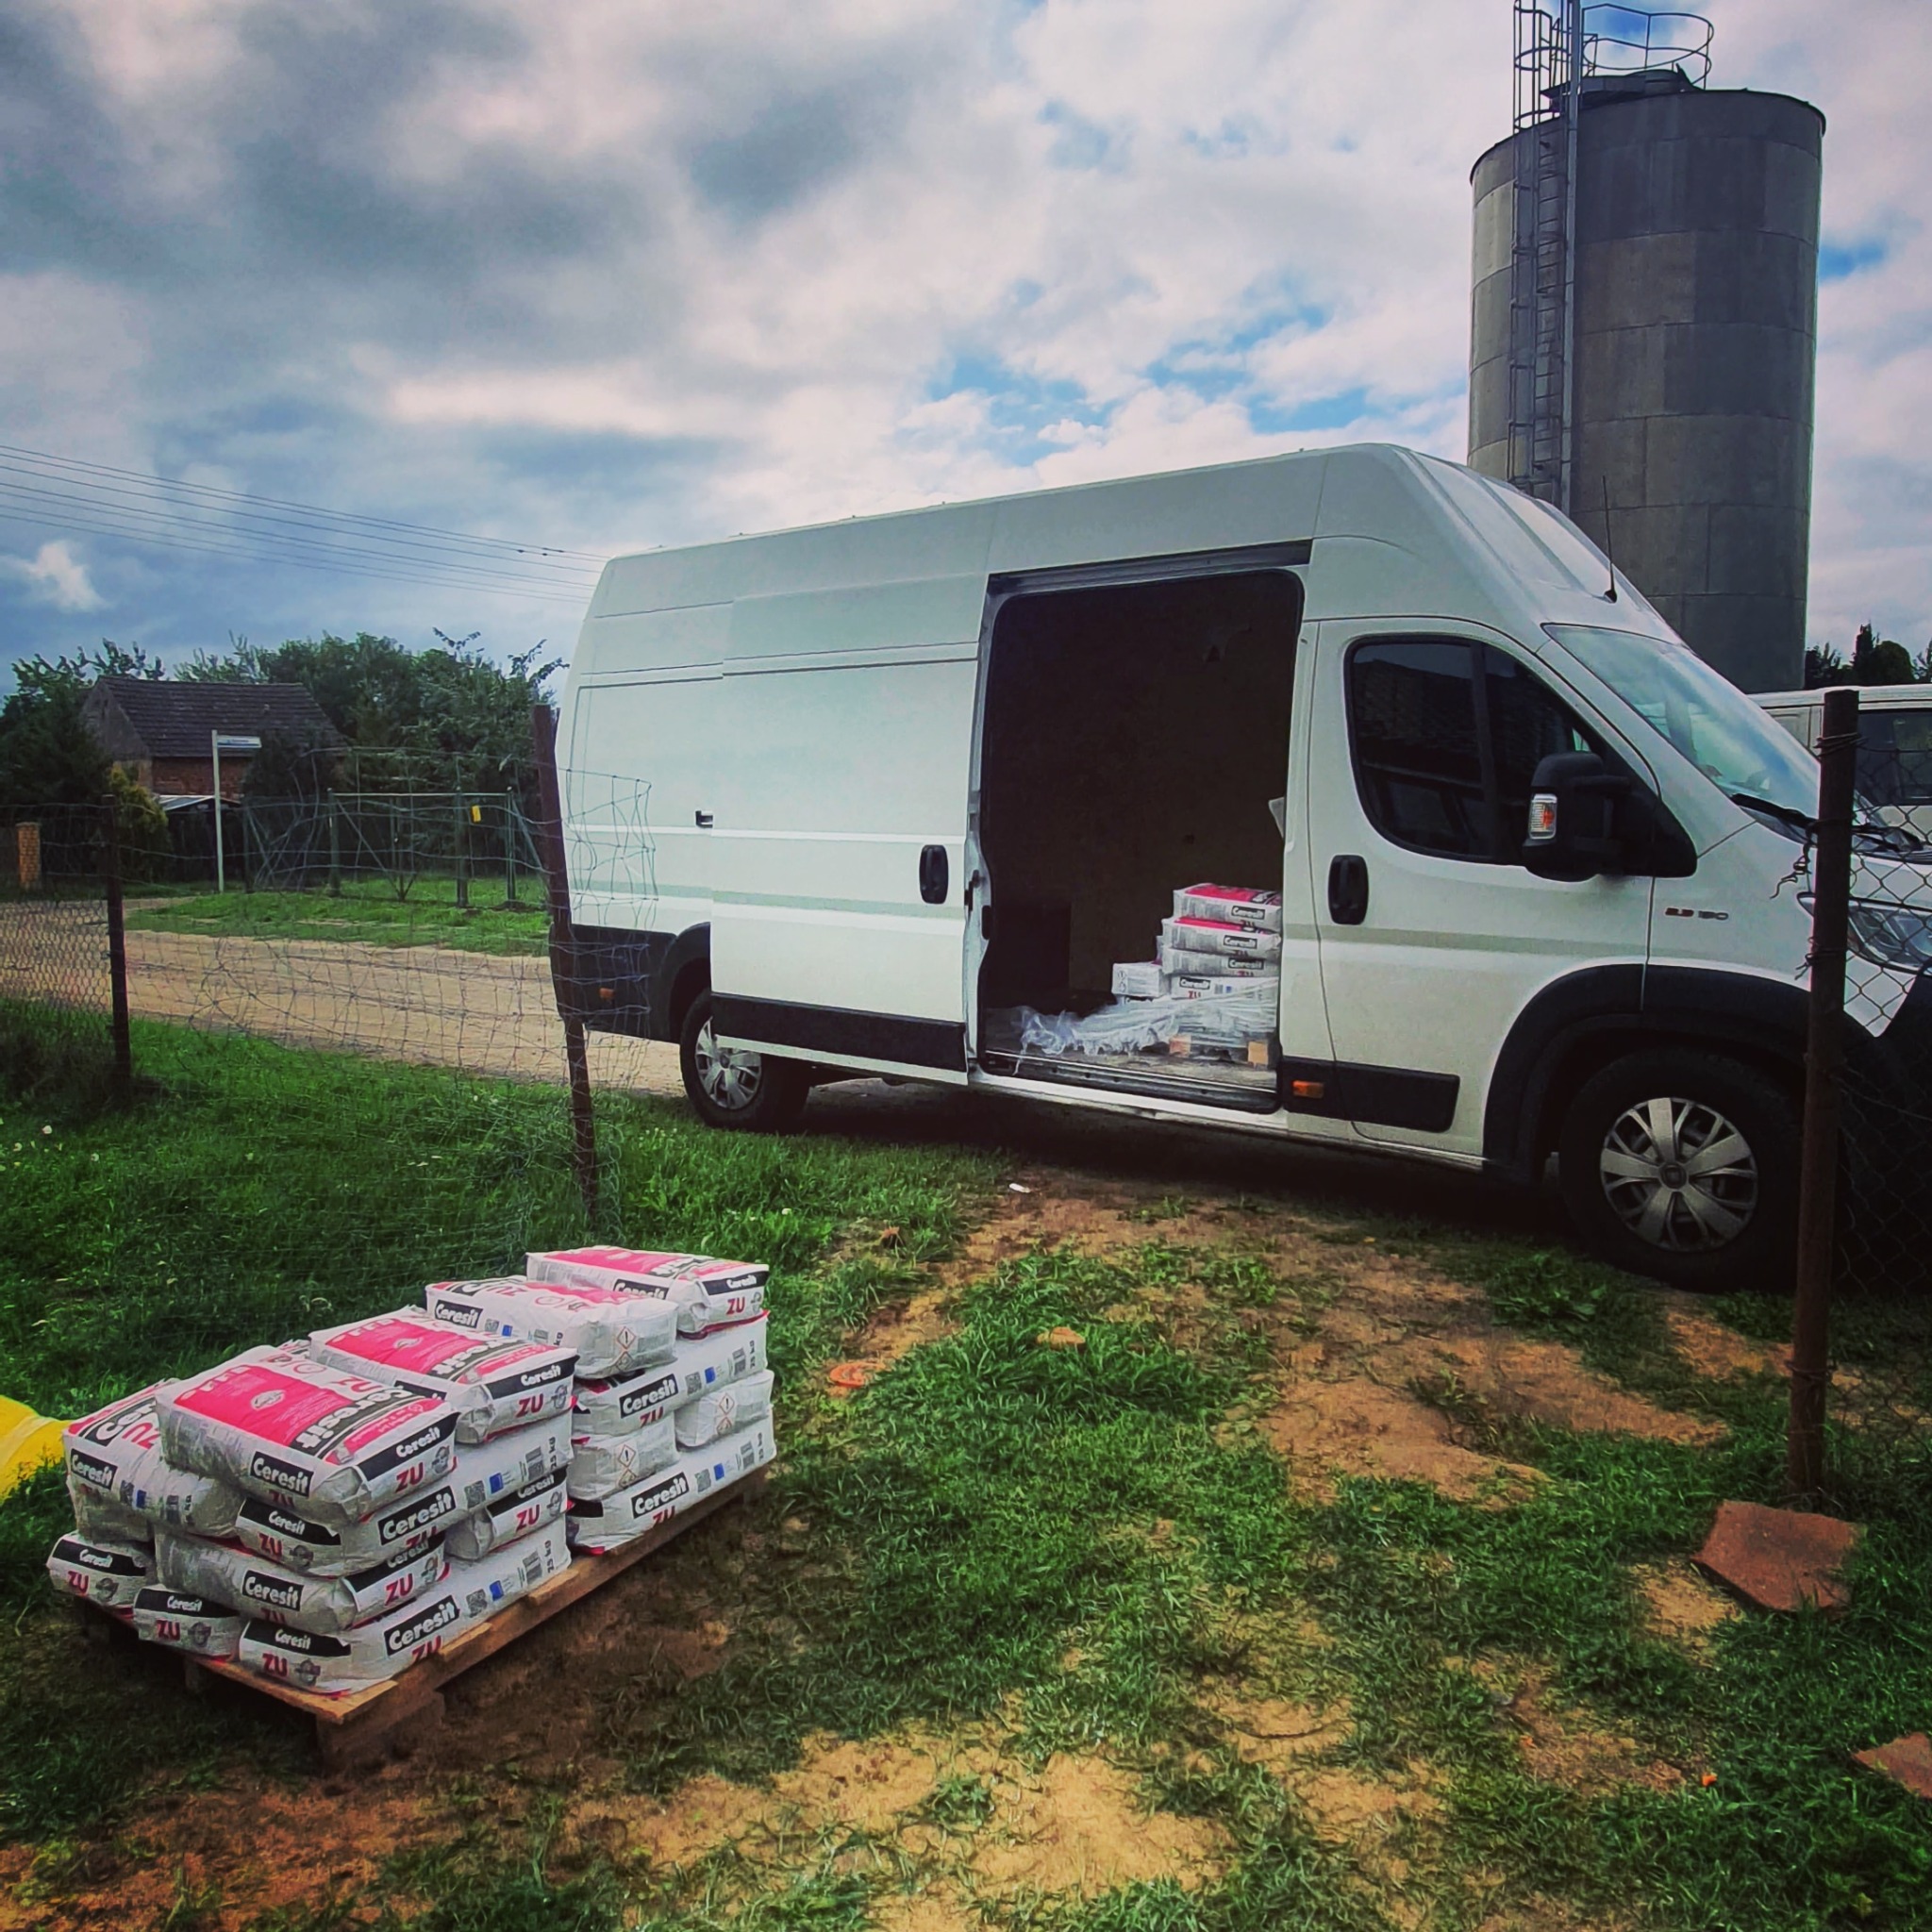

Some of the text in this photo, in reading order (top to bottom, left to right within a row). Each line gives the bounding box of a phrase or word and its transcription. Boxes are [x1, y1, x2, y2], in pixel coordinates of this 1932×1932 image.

[726, 1274, 758, 1290] Ceresit
[435, 1304, 479, 1327] Ceresit
[725, 1296, 745, 1316] ZU
[520, 1364, 562, 1387] Ceresit
[516, 1393, 544, 1418] ZU
[623, 1378, 676, 1415] Ceresit
[294, 1389, 413, 1449] Ceresit
[395, 1426, 441, 1457] Ceresit
[71, 1455, 112, 1488] Ceresit
[253, 1457, 309, 1495] Ceresit
[394, 1462, 425, 1493] ZU
[634, 1477, 688, 1516] Ceresit
[268, 1510, 306, 1536] Ceresit
[382, 1493, 453, 1540] Ceresit
[515, 1505, 541, 1533] ZU
[258, 1532, 283, 1558] ZU
[80, 1549, 113, 1569] Ceresit
[68, 1571, 90, 1596] ZU
[245, 1576, 299, 1609] Ceresit
[385, 1574, 413, 1606] ZU
[167, 1595, 203, 1612] Ceresit
[156, 1620, 181, 1641] ZU
[389, 1601, 457, 1650] Ceresit
[275, 1629, 311, 1650] Ceresit
[262, 1653, 288, 1677] ZU
